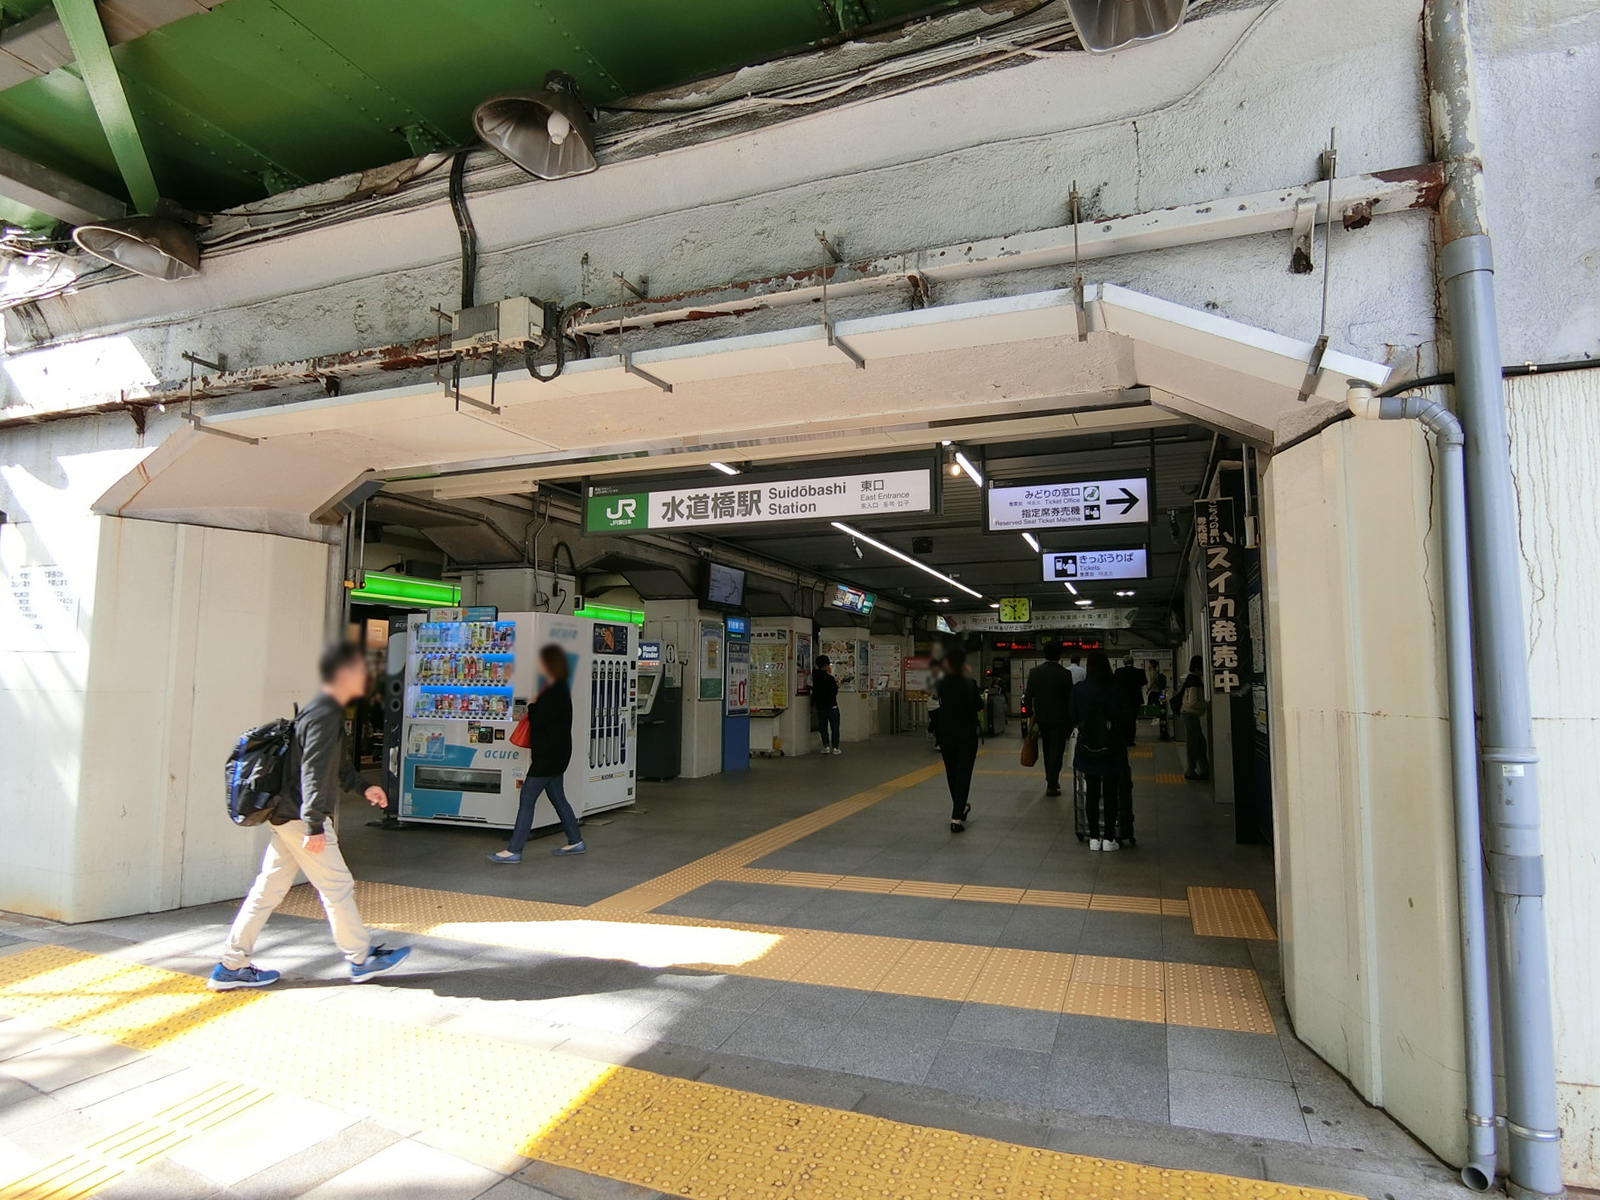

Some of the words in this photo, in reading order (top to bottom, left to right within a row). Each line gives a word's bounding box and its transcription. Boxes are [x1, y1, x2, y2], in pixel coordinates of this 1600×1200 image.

[768, 482, 847, 500] Suidōbashi
[860, 479, 884, 492] 東口
[860, 493, 876, 501] East
[878, 492, 910, 500] Entrance
[1025, 487, 1080, 499] みどりの窓口
[606, 498, 637, 519] JR
[661, 489, 762, 523] 水道橋駅
[768, 501, 817, 515] Station
[1021, 506, 1081, 518] 指定席券売機
[1079, 552, 1134, 564] きっぷうりば
[1207, 547, 1240, 693] スイカ発売中
[484, 749, 519, 760] acure
